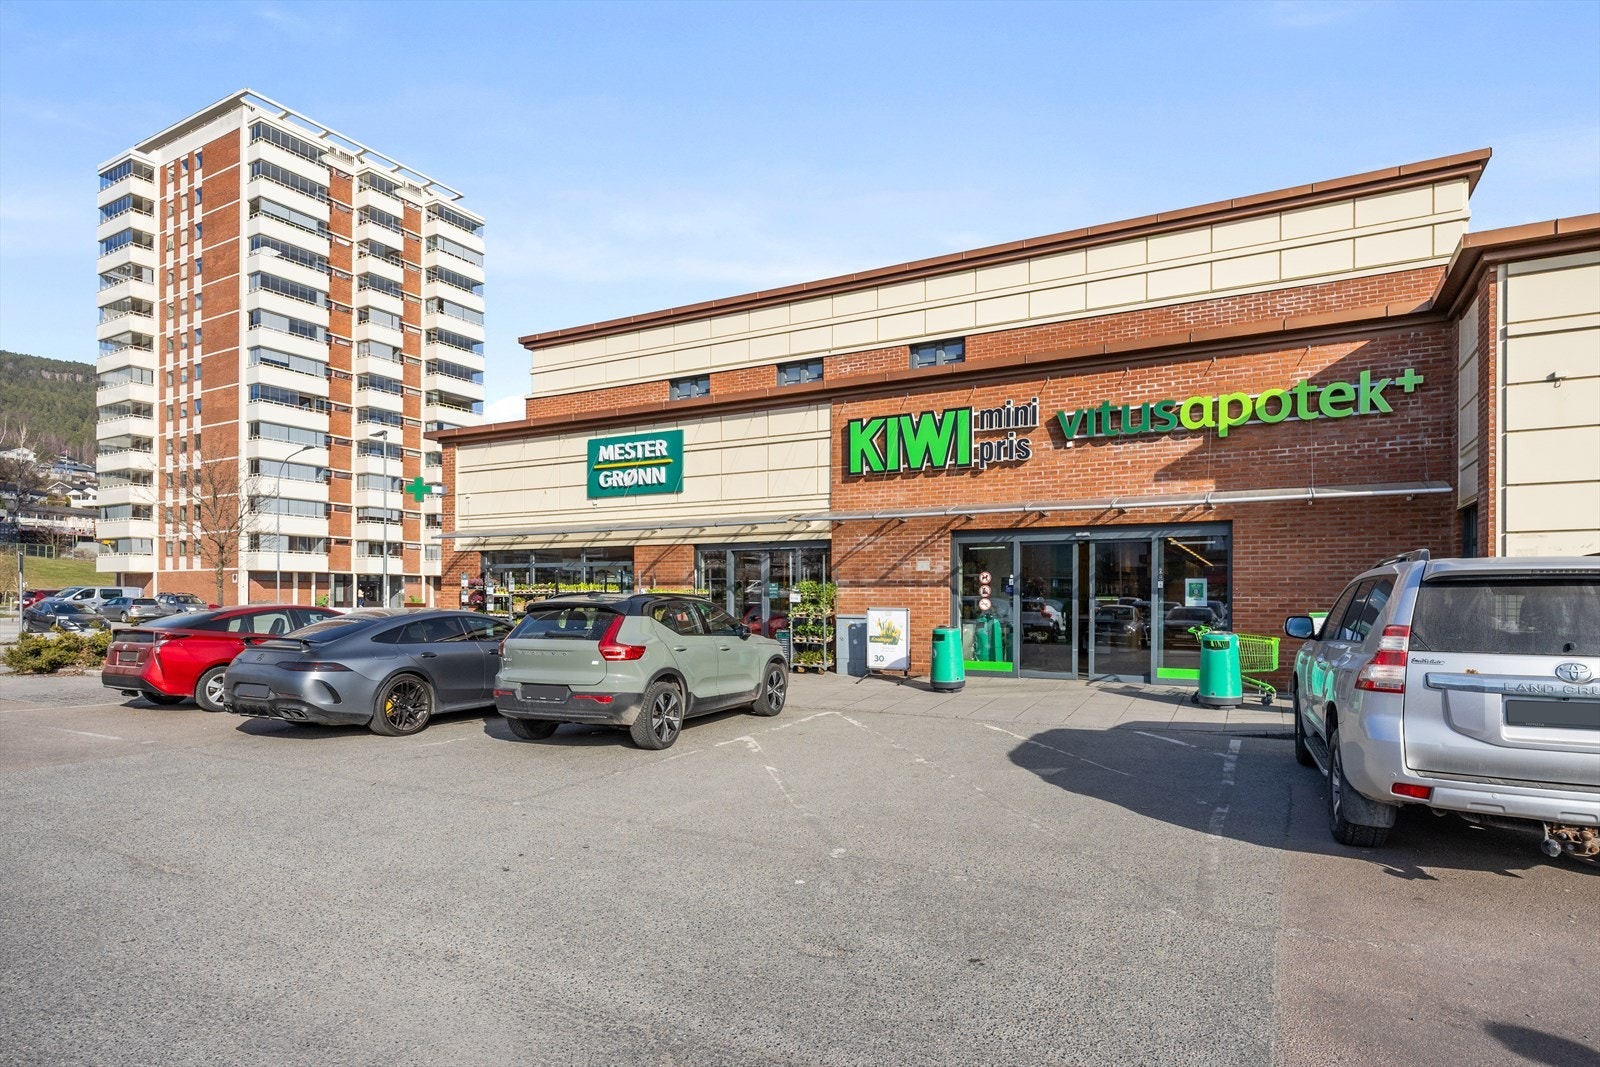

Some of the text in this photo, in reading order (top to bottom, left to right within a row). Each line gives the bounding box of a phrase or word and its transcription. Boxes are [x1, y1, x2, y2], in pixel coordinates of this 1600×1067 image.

[979, 397, 1039, 430] mini
[598, 439, 668, 462] MESTER
[848, 406, 974, 475] KIWI
[978, 432, 1032, 469] pris
[598, 466, 666, 488] GRØNN
[1503, 682, 1556, 694] LAND
